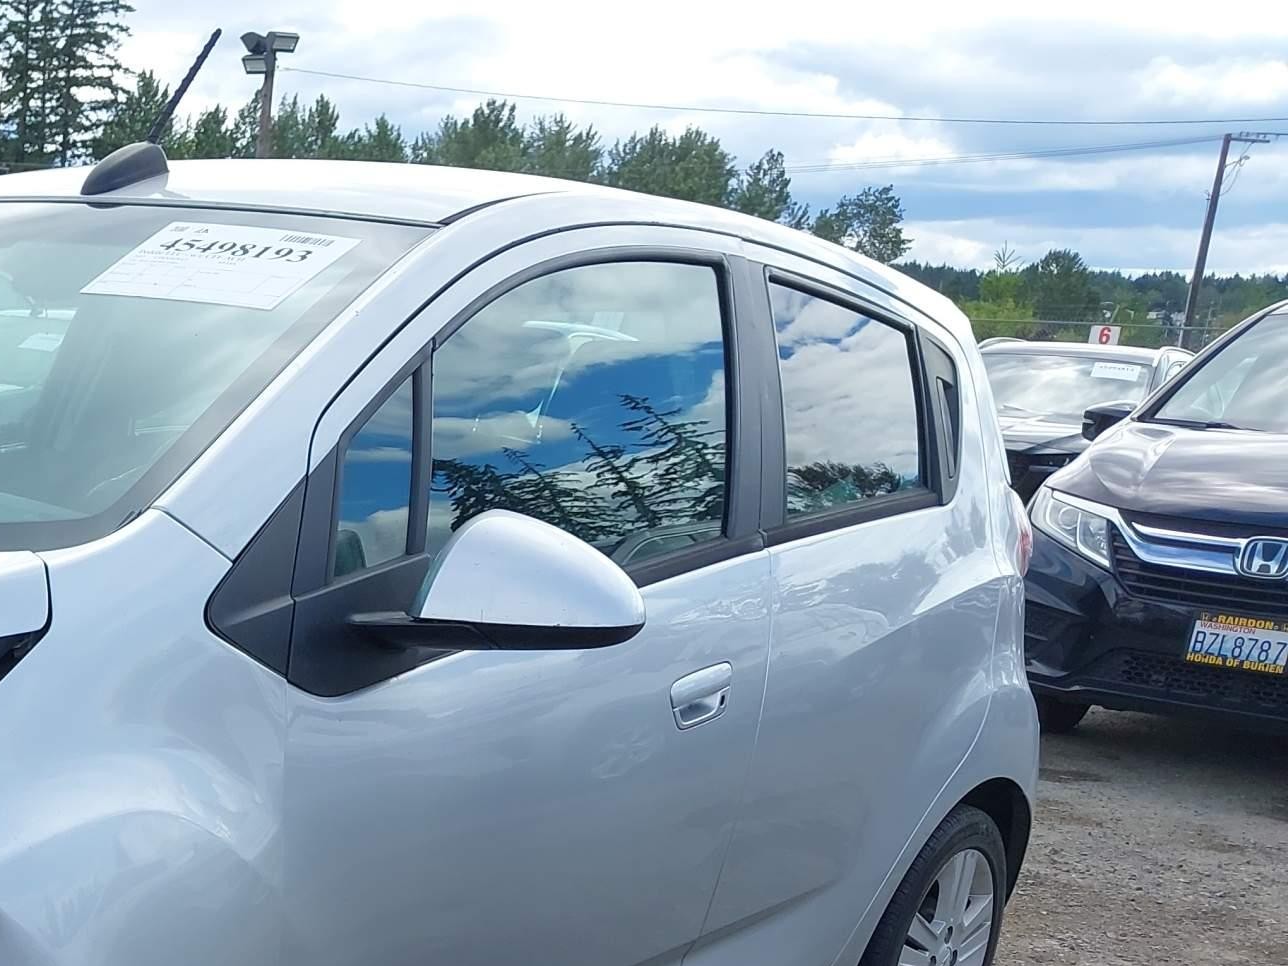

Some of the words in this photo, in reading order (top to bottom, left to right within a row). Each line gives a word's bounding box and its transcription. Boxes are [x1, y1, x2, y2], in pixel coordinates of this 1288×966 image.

[159, 237, 313, 263] 45498193
[1098, 326, 1112, 345] 6
[1201, 621, 1256, 634] WASHINGTON
[1218, 615, 1274, 629] RAIRDON
[1192, 631, 1288, 664] BZL8787
[1186, 653, 1223, 665] HONDA
[1226, 658, 1240, 667] OF
[1243, 661, 1284, 673] BURIEN
